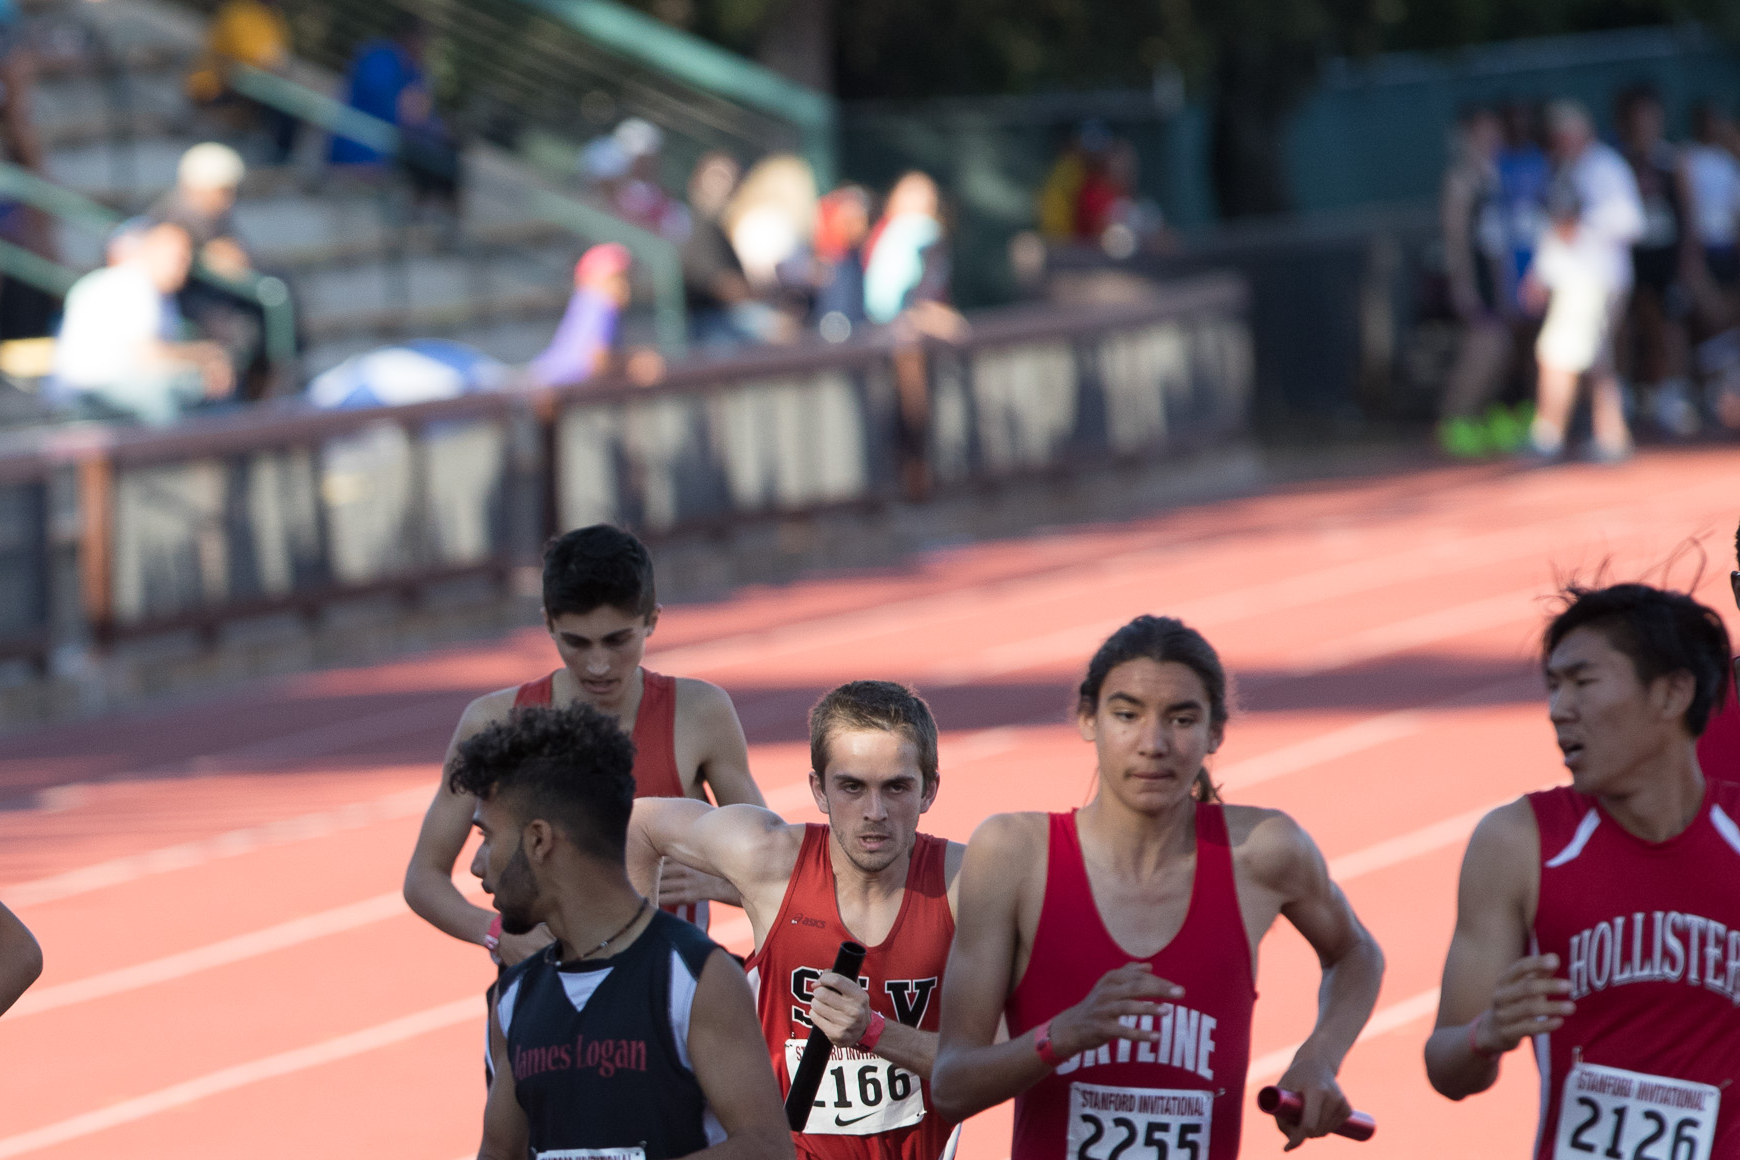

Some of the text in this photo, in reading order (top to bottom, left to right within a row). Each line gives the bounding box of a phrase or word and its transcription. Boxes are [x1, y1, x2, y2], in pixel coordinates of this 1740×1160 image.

[791, 966, 938, 1030] SV
[514, 1034, 647, 1081] James Logan
[1056, 1001, 1217, 1081] YLINE
[812, 1062, 912, 1109] 166
[1081, 1089, 1205, 1117] STANFORD INVITATIONAL
[1575, 1070, 1707, 1112] STANFORD INVITATIONAL
